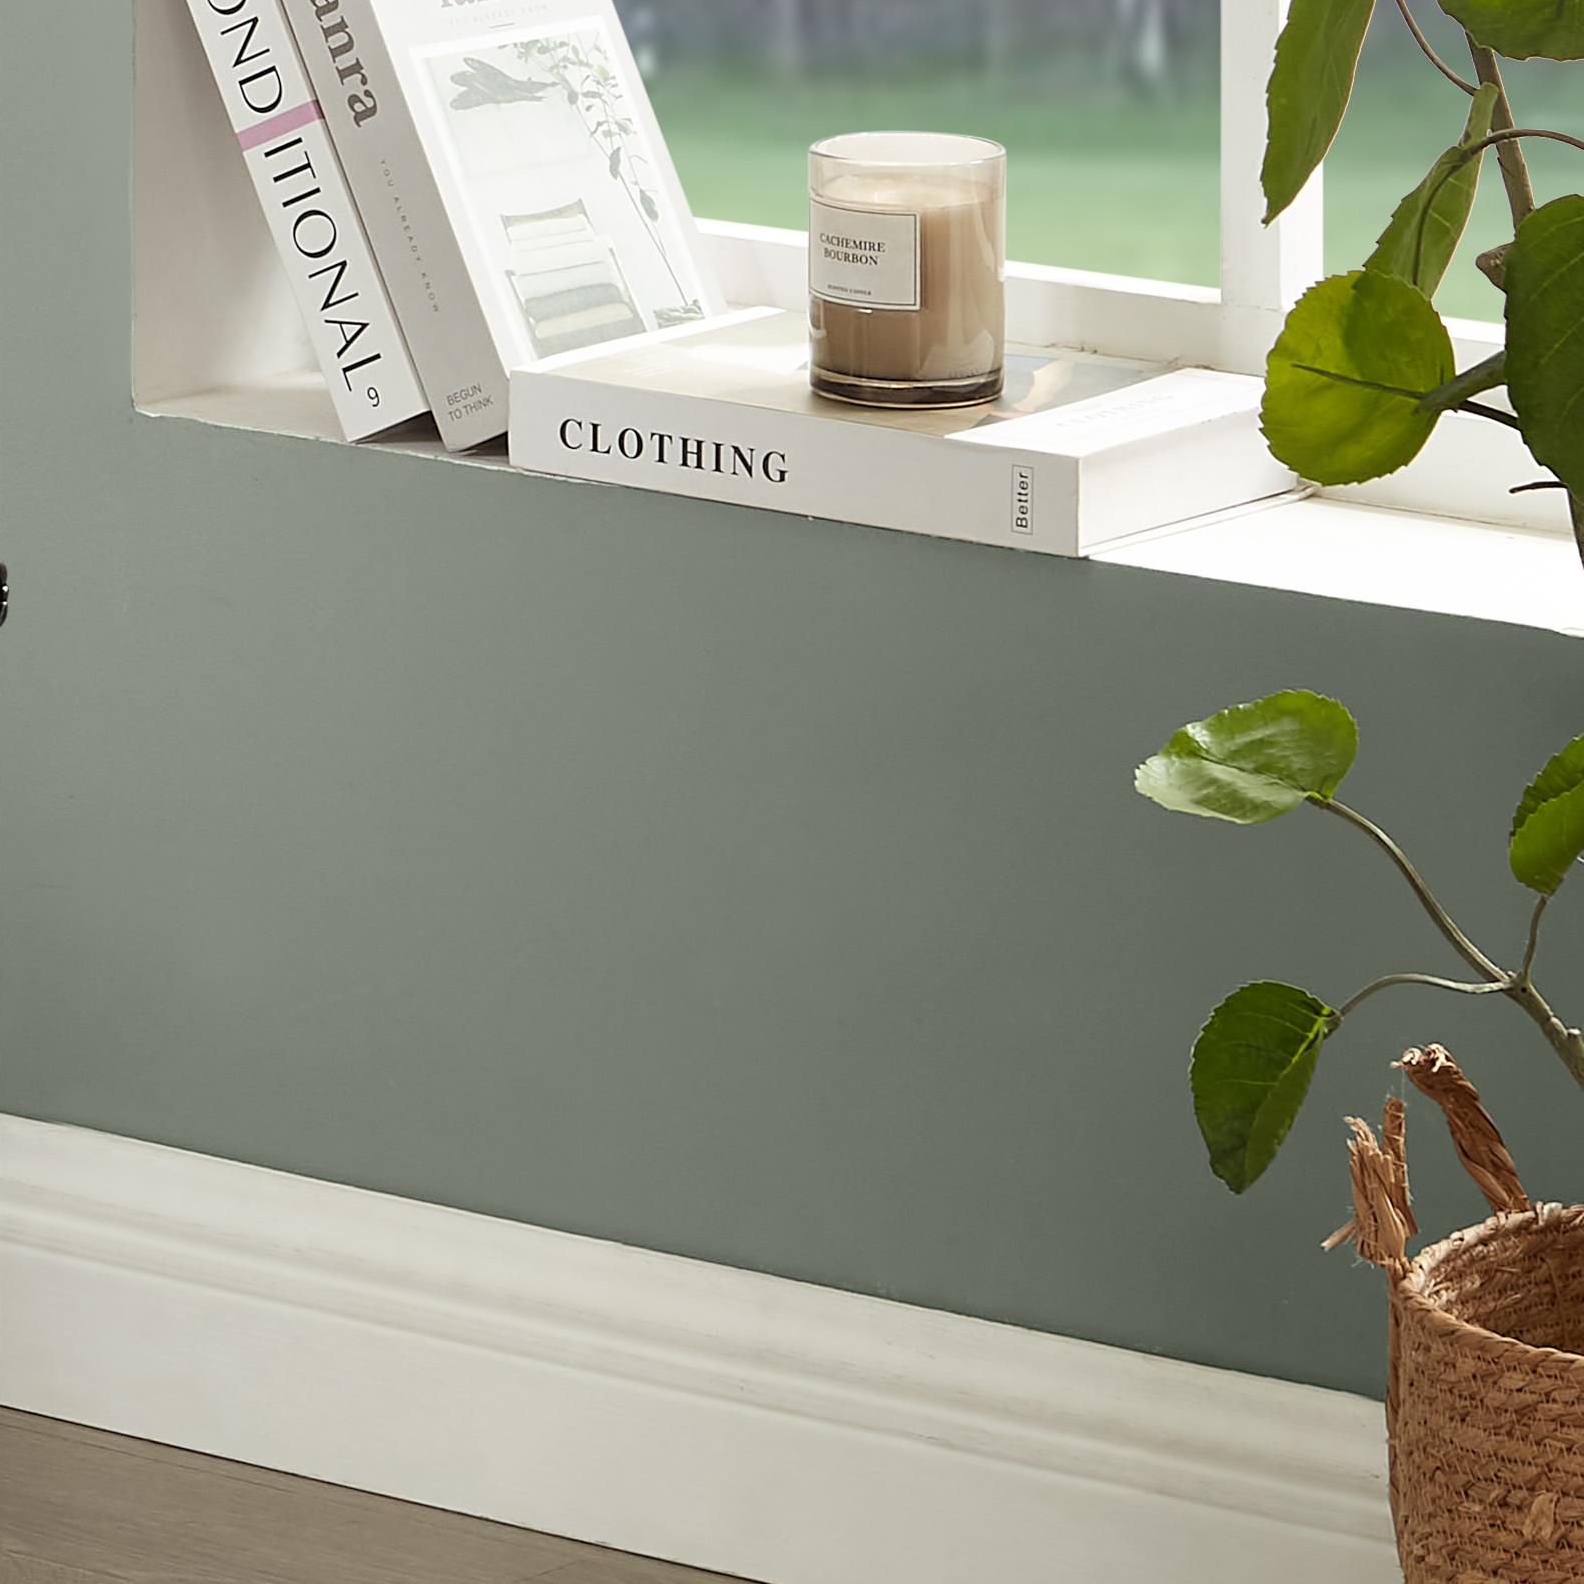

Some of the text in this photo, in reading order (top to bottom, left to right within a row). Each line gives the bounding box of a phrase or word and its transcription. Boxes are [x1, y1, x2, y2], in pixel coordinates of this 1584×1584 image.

[380, 158, 440, 313] YOU ALREADY KNOW
[819, 232, 886, 253] CACHEMIRE
[823, 247, 879, 266] BOURBON
[366, 386, 381, 408] 9
[446, 382, 483, 406] BEGUN
[447, 394, 494, 422] TO THINK
[558, 417, 790, 484] CLOTHING
[1015, 471, 1030, 530] Better
